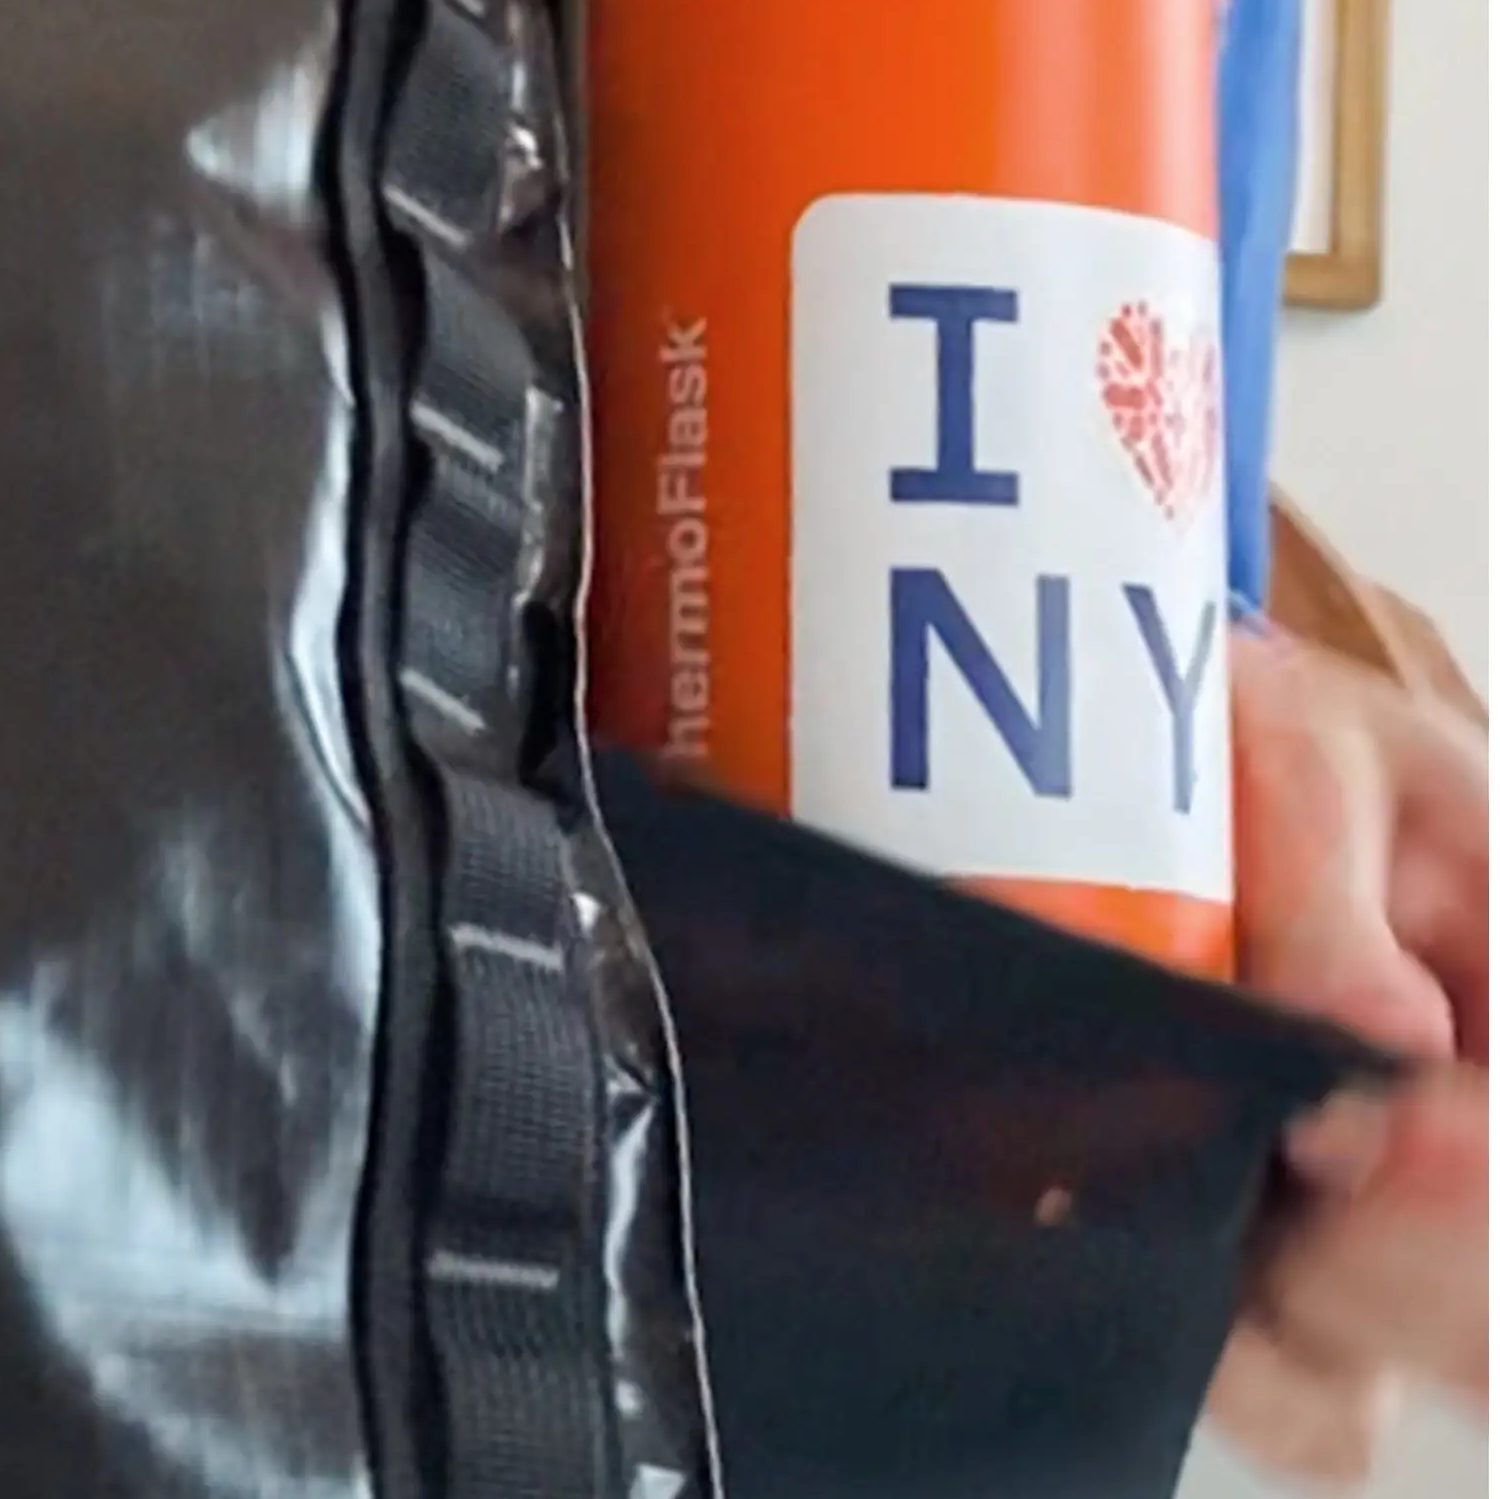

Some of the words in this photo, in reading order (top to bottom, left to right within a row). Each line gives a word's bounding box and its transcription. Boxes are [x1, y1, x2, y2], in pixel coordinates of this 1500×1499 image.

[888, 283, 1020, 507] I
[657, 316, 712, 760] hermoFlask
[888, 566, 1218, 815] NY
